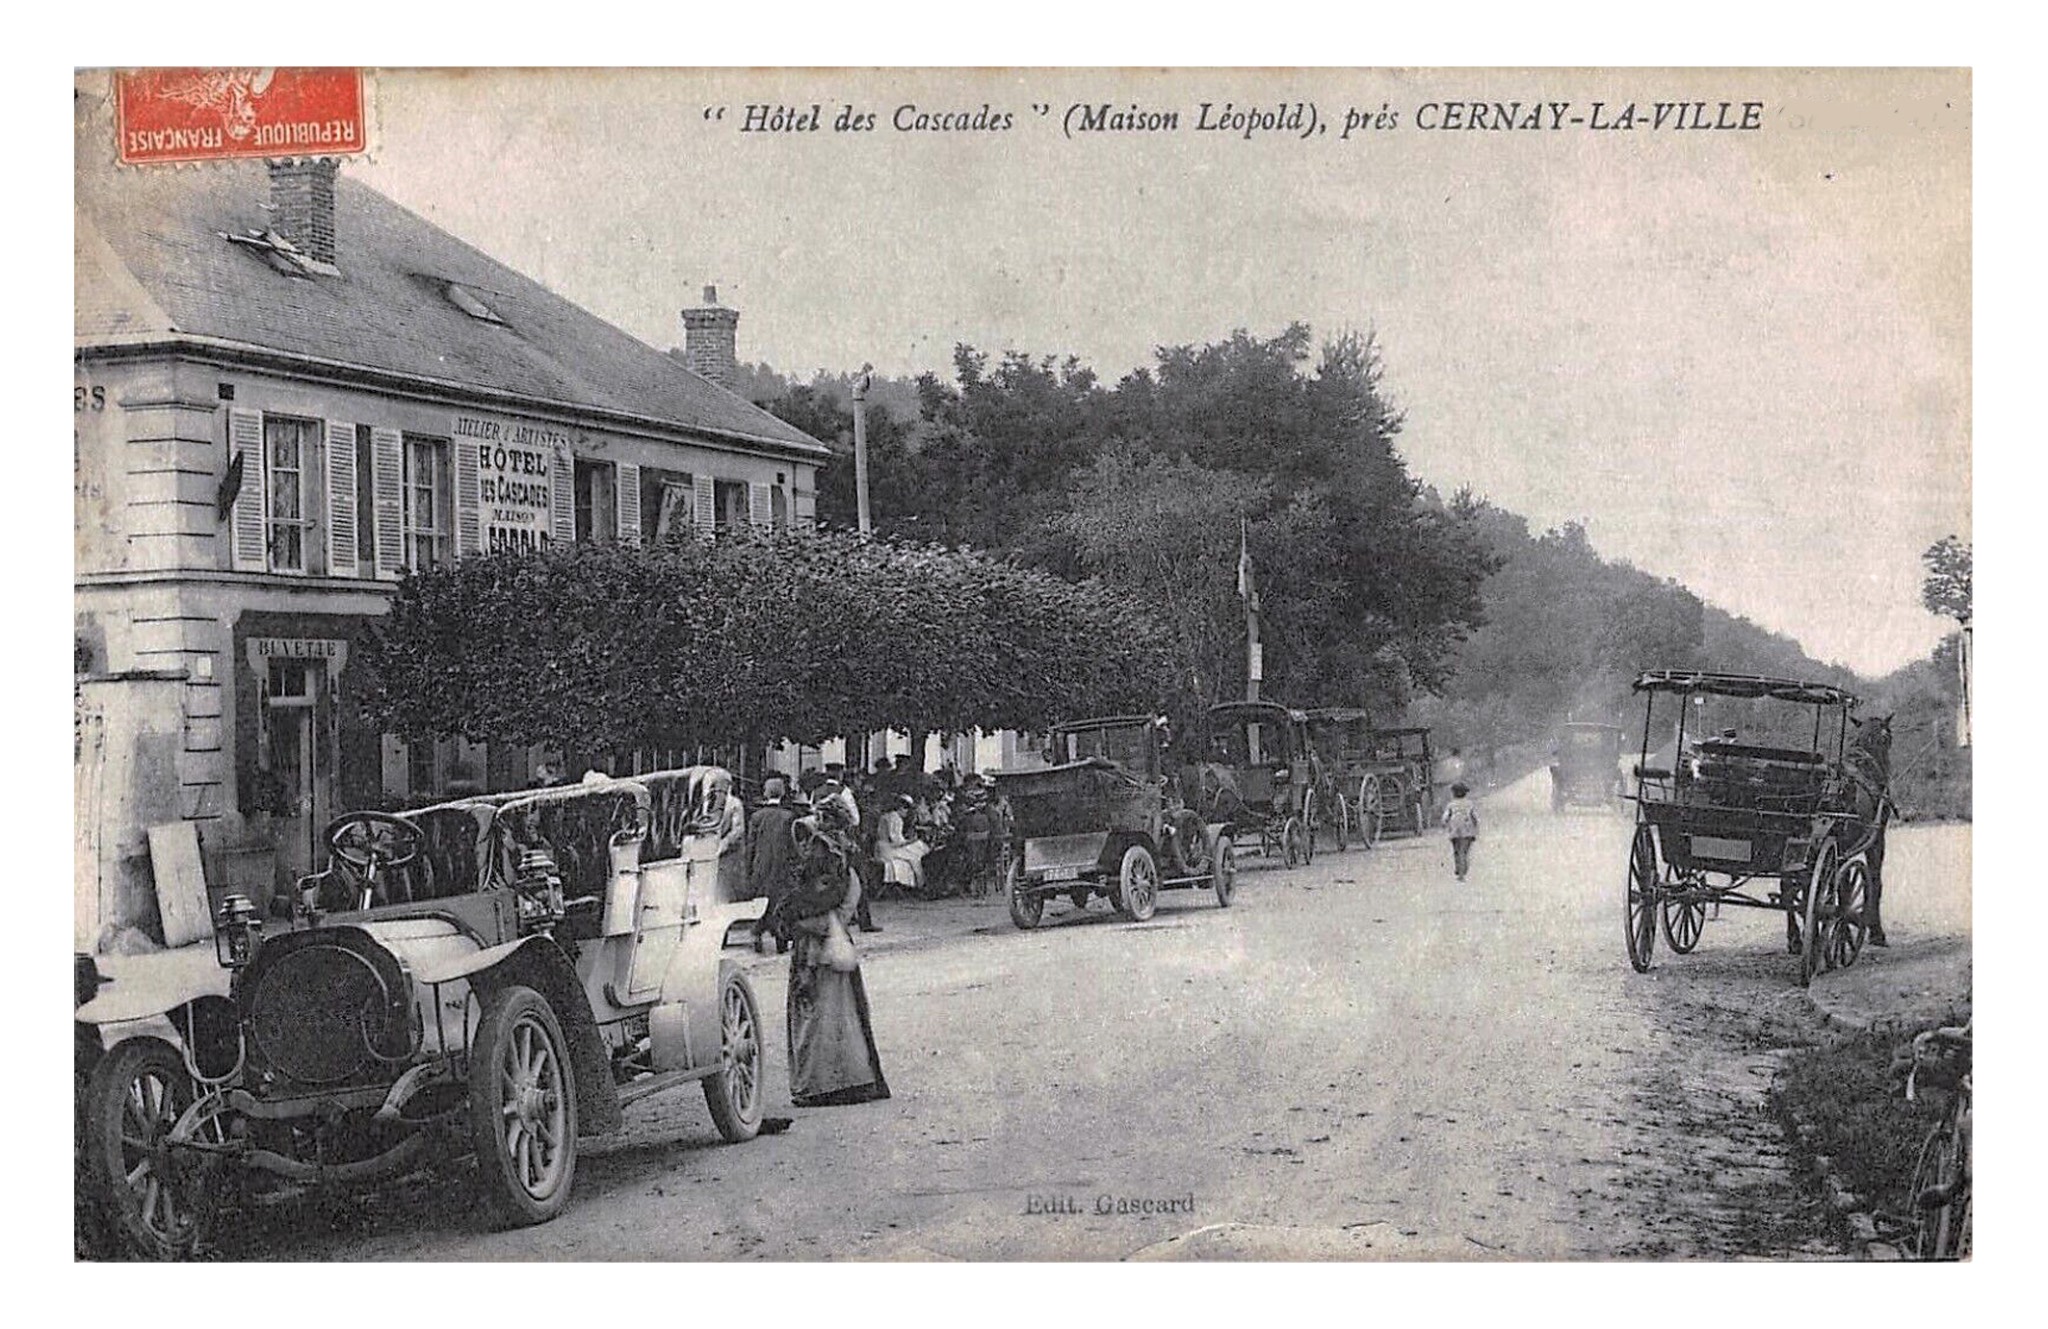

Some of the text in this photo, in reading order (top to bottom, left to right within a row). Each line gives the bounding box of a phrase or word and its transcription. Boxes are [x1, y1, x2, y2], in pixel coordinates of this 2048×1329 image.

[129, 119, 355, 153] REPUBLIQUE FRANÇAISE
[259, 640, 336, 657] BUVETTE
